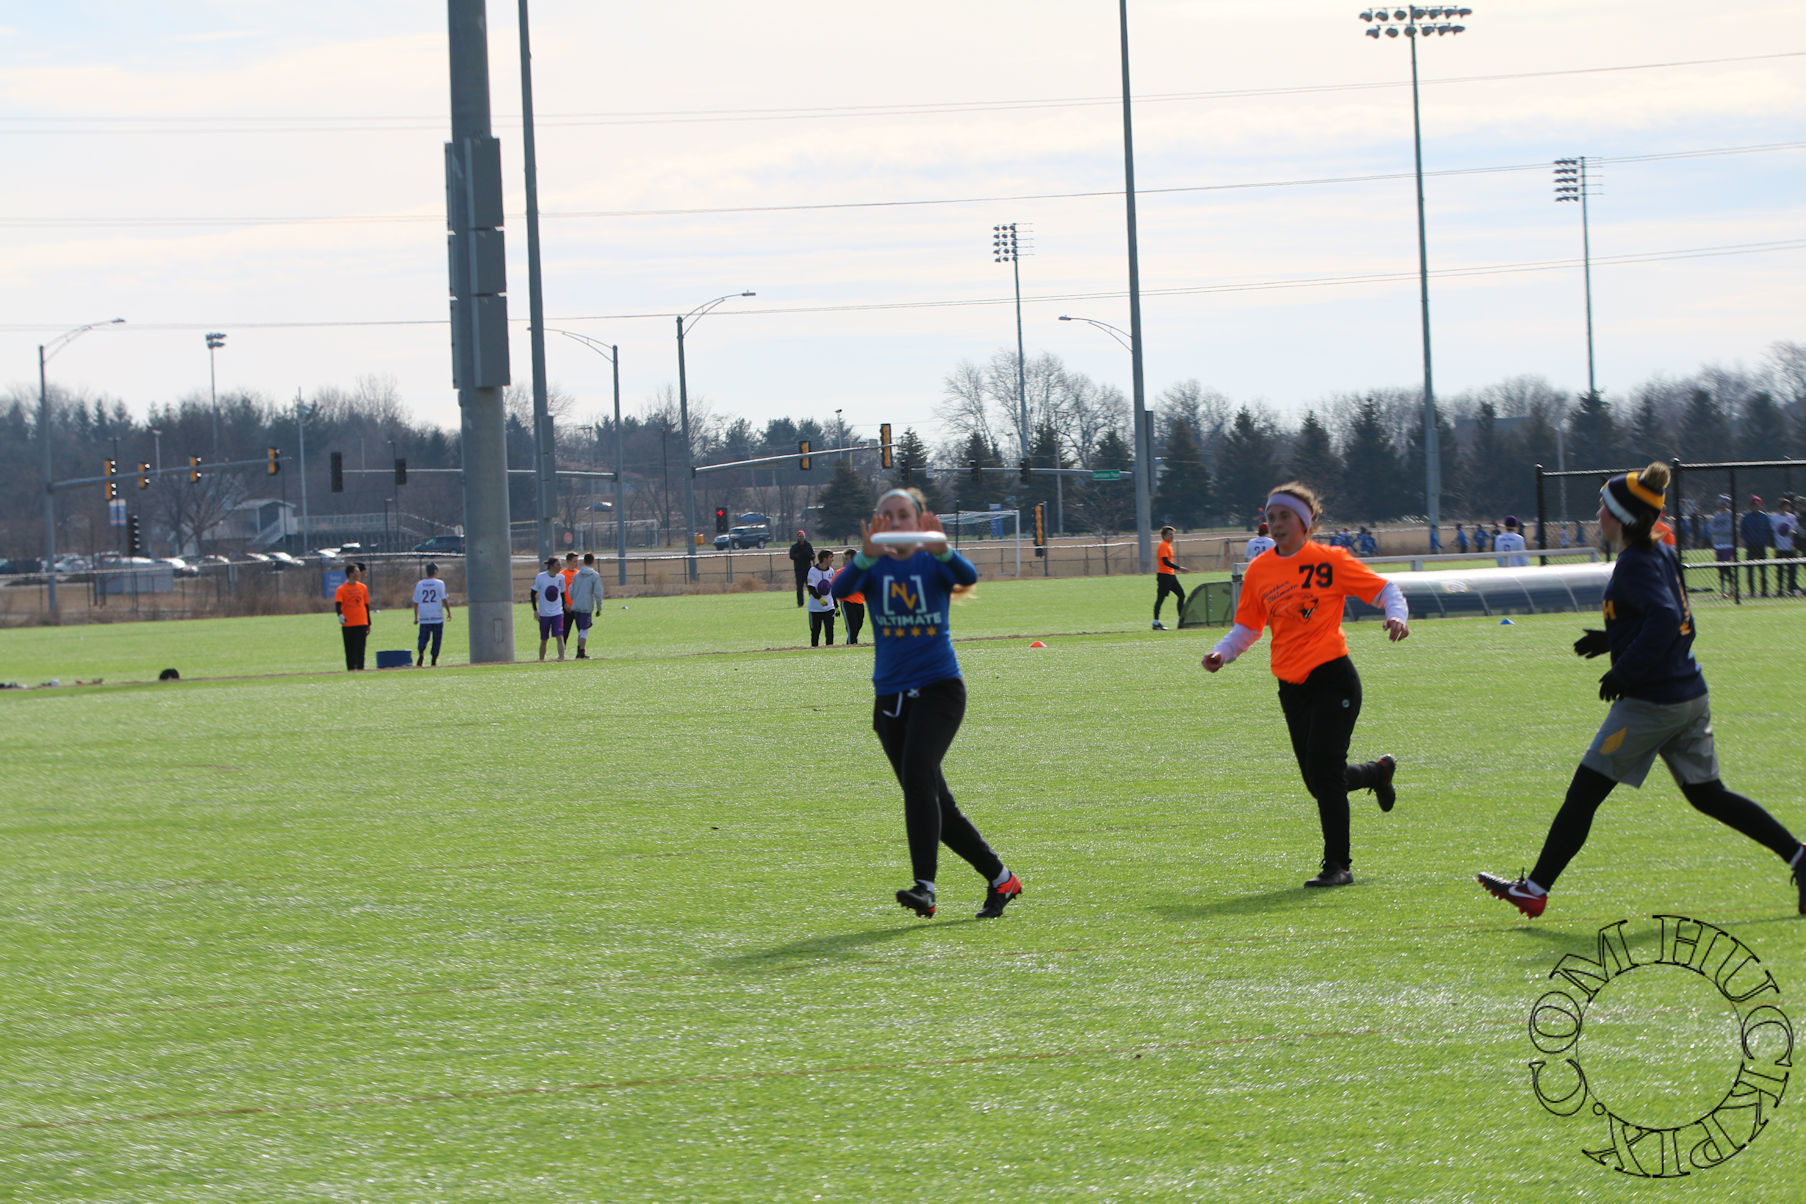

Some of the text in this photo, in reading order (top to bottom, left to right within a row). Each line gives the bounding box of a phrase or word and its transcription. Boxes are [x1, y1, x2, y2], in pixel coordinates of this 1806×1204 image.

[1299, 562, 1333, 589] 79
[422, 589, 437, 603] 22
[875, 612, 941, 626] ULTIMATE
